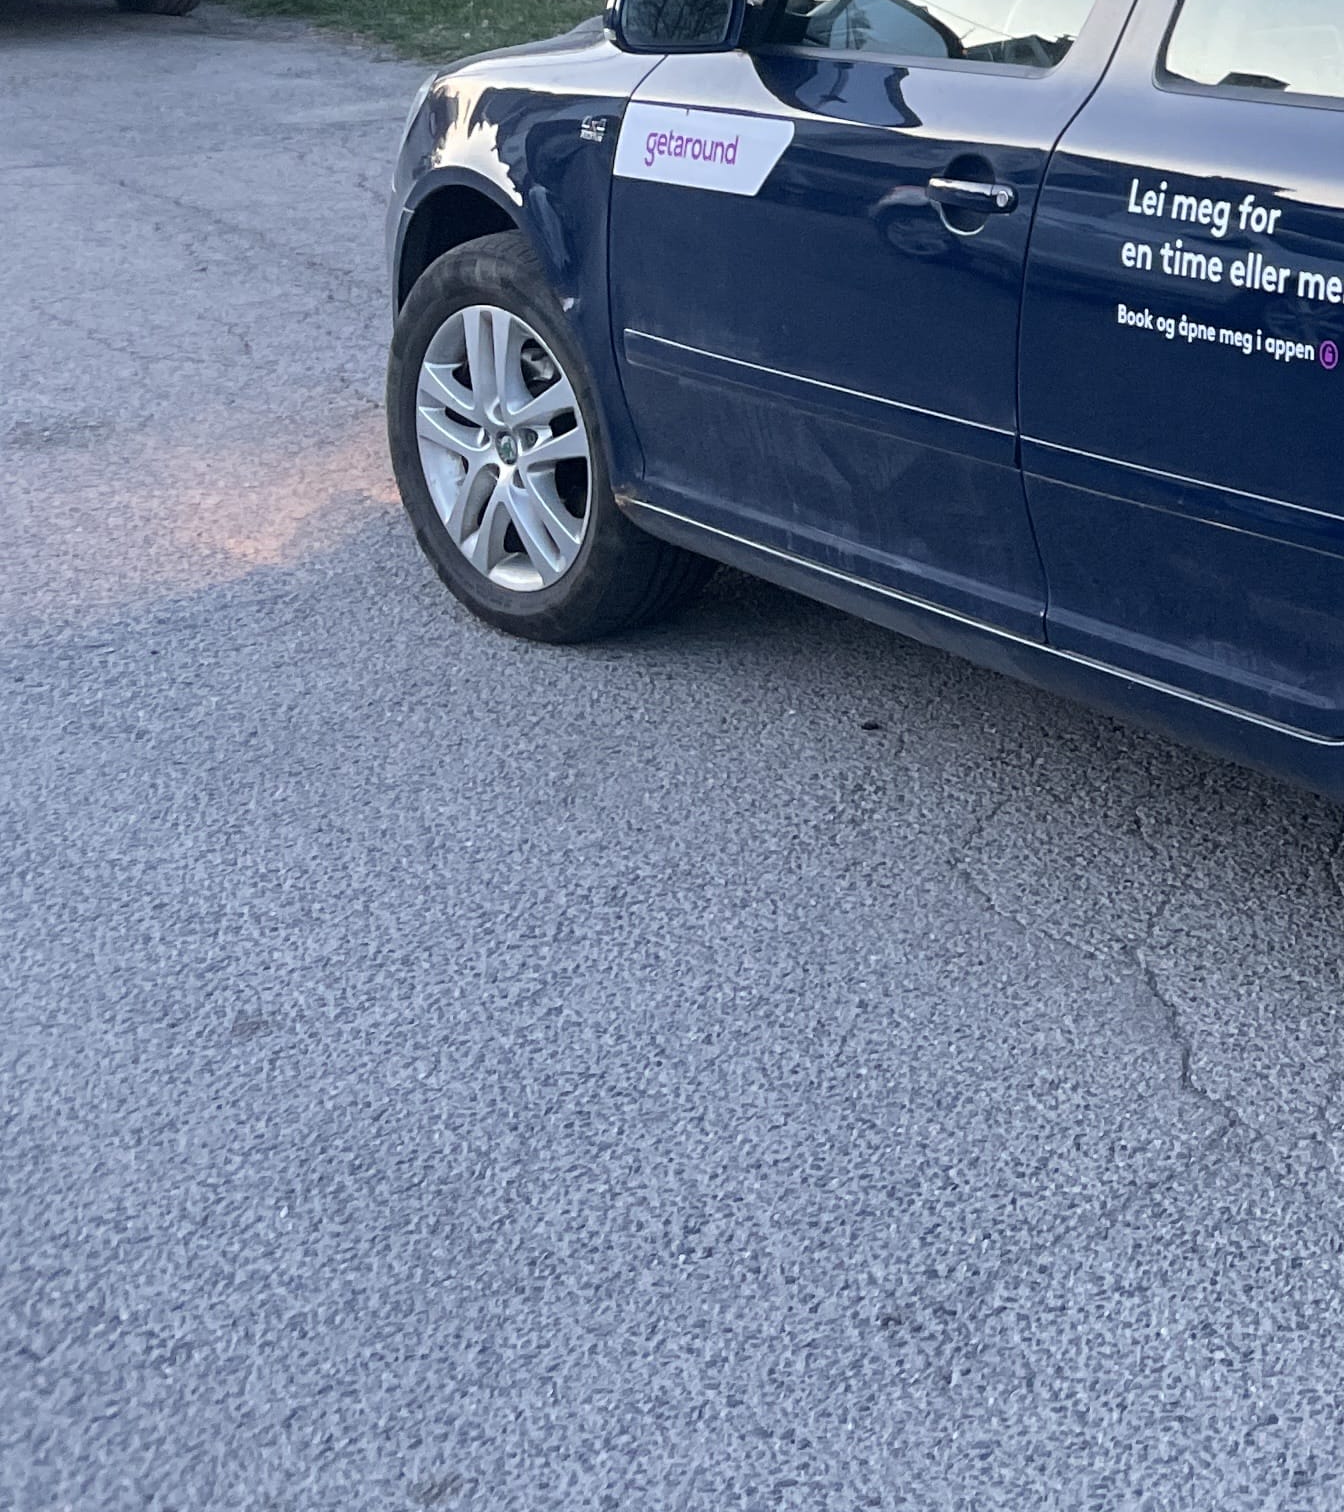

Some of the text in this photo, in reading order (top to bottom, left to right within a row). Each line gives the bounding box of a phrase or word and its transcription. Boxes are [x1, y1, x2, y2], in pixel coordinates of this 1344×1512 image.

[644, 129, 739, 167] getaround
[1128, 178, 1282, 238] Lei meg for
[1121, 241, 1152, 270] en
[1159, 239, 1223, 282] time
[1229, 252, 1291, 294] eller
[1117, 303, 1315, 362] Book og åpne meg i appen
